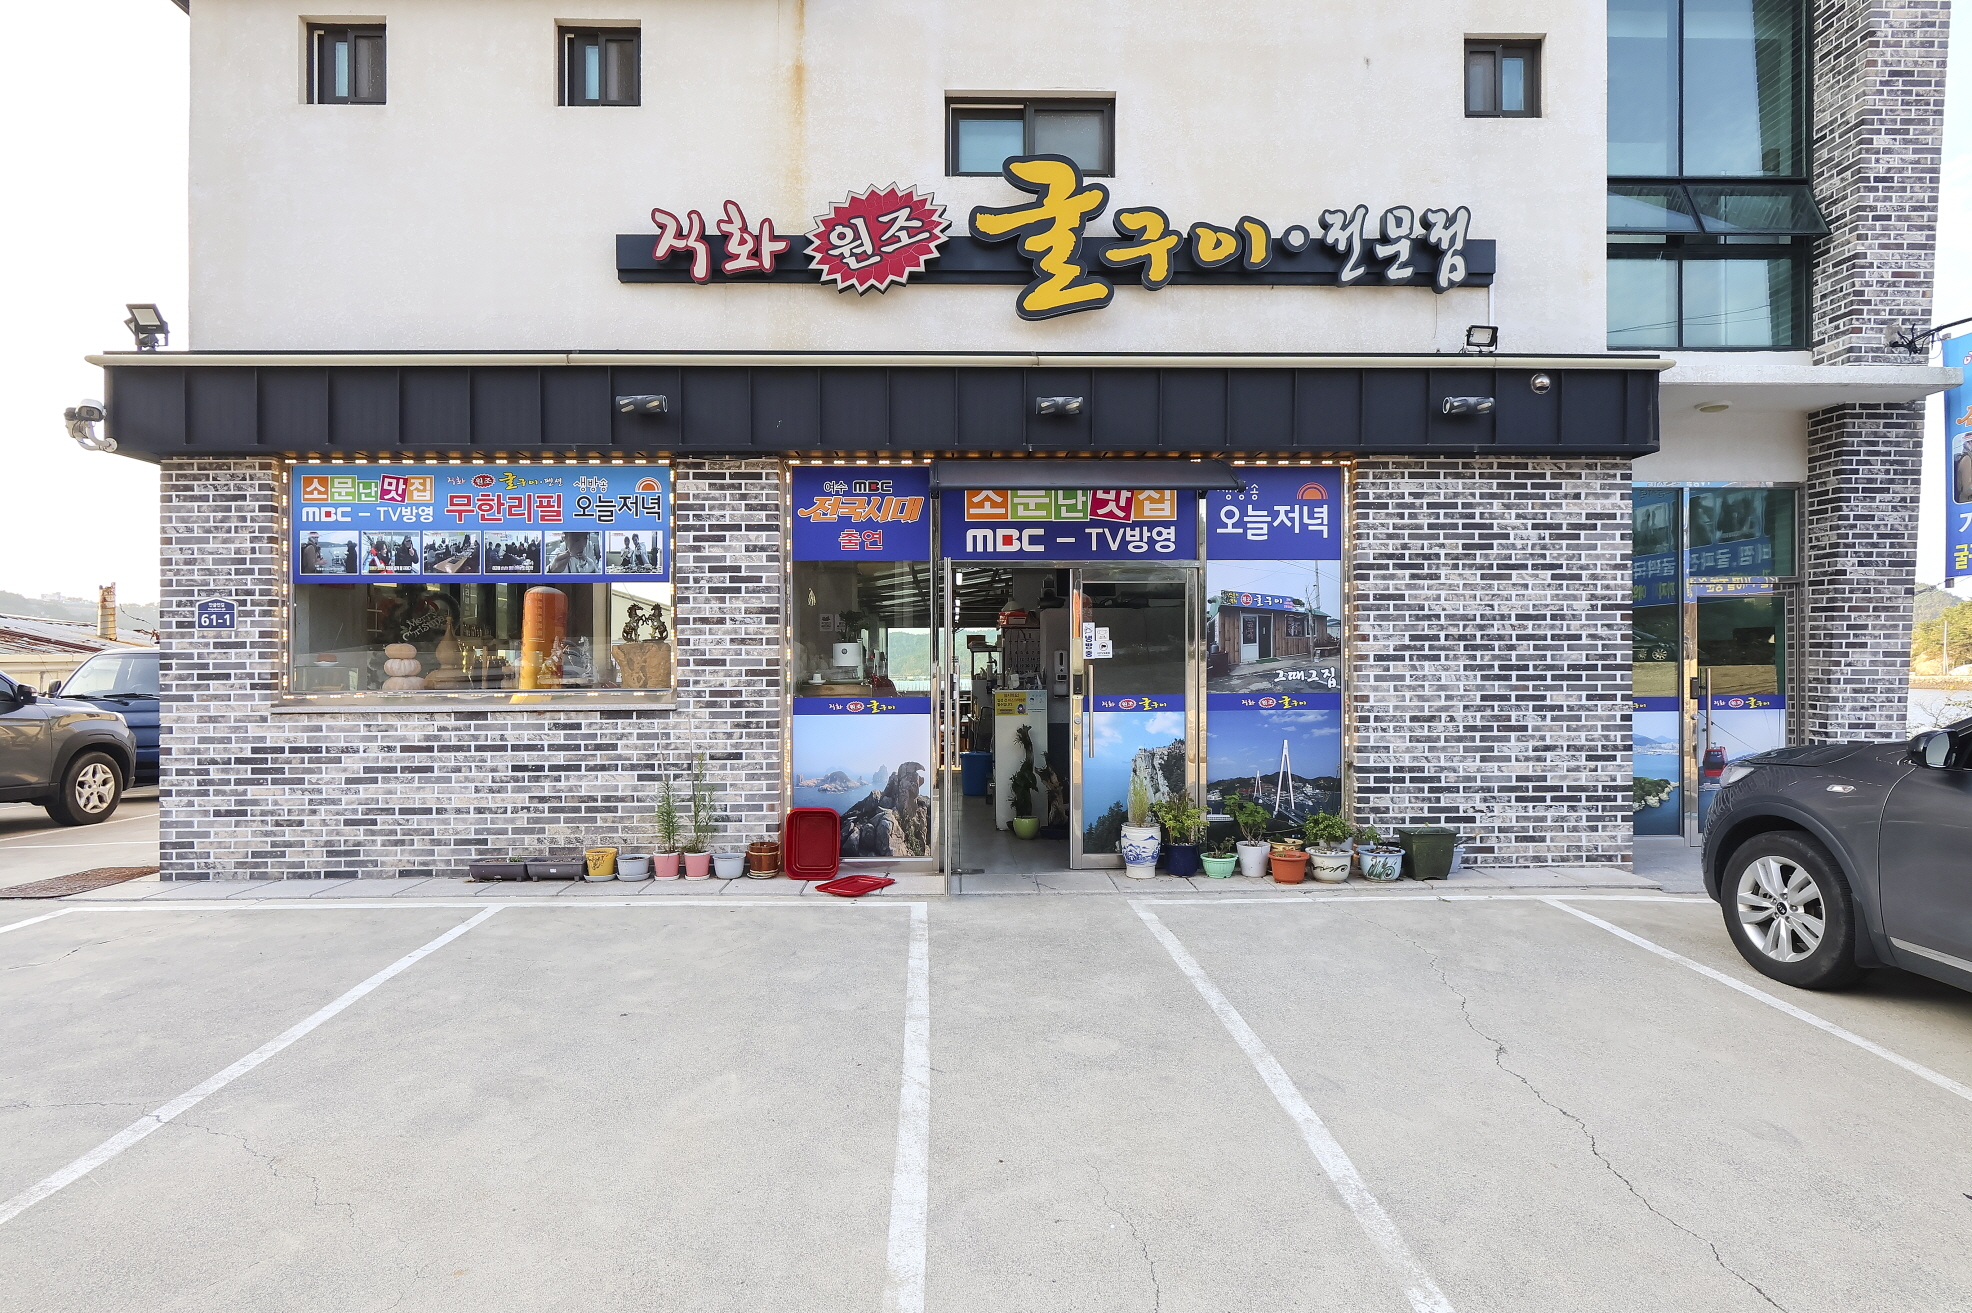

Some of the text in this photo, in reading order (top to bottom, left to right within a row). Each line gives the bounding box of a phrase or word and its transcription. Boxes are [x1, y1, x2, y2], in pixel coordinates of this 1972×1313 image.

[651, 199, 790, 284] 직화
[827, 205, 930, 271] 원조
[969, 154, 1272, 320] 굴구이
[1318, 204, 1473, 293] 전문점
[573, 475, 608, 492] 생방송
[824, 479, 893, 494] 여수 MBC
[302, 507, 352, 522] MBC
[376, 505, 434, 523] TV방영
[444, 493, 564, 524] 무한리필
[797, 496, 925, 524] 전국시대
[838, 529, 883, 551] 출연
[966, 528, 1045, 552] MBC
[1084, 526, 1176, 553] TV방영
[1253, 594, 1283, 606] 굴구이
[201, 613, 231, 626] 61-1
